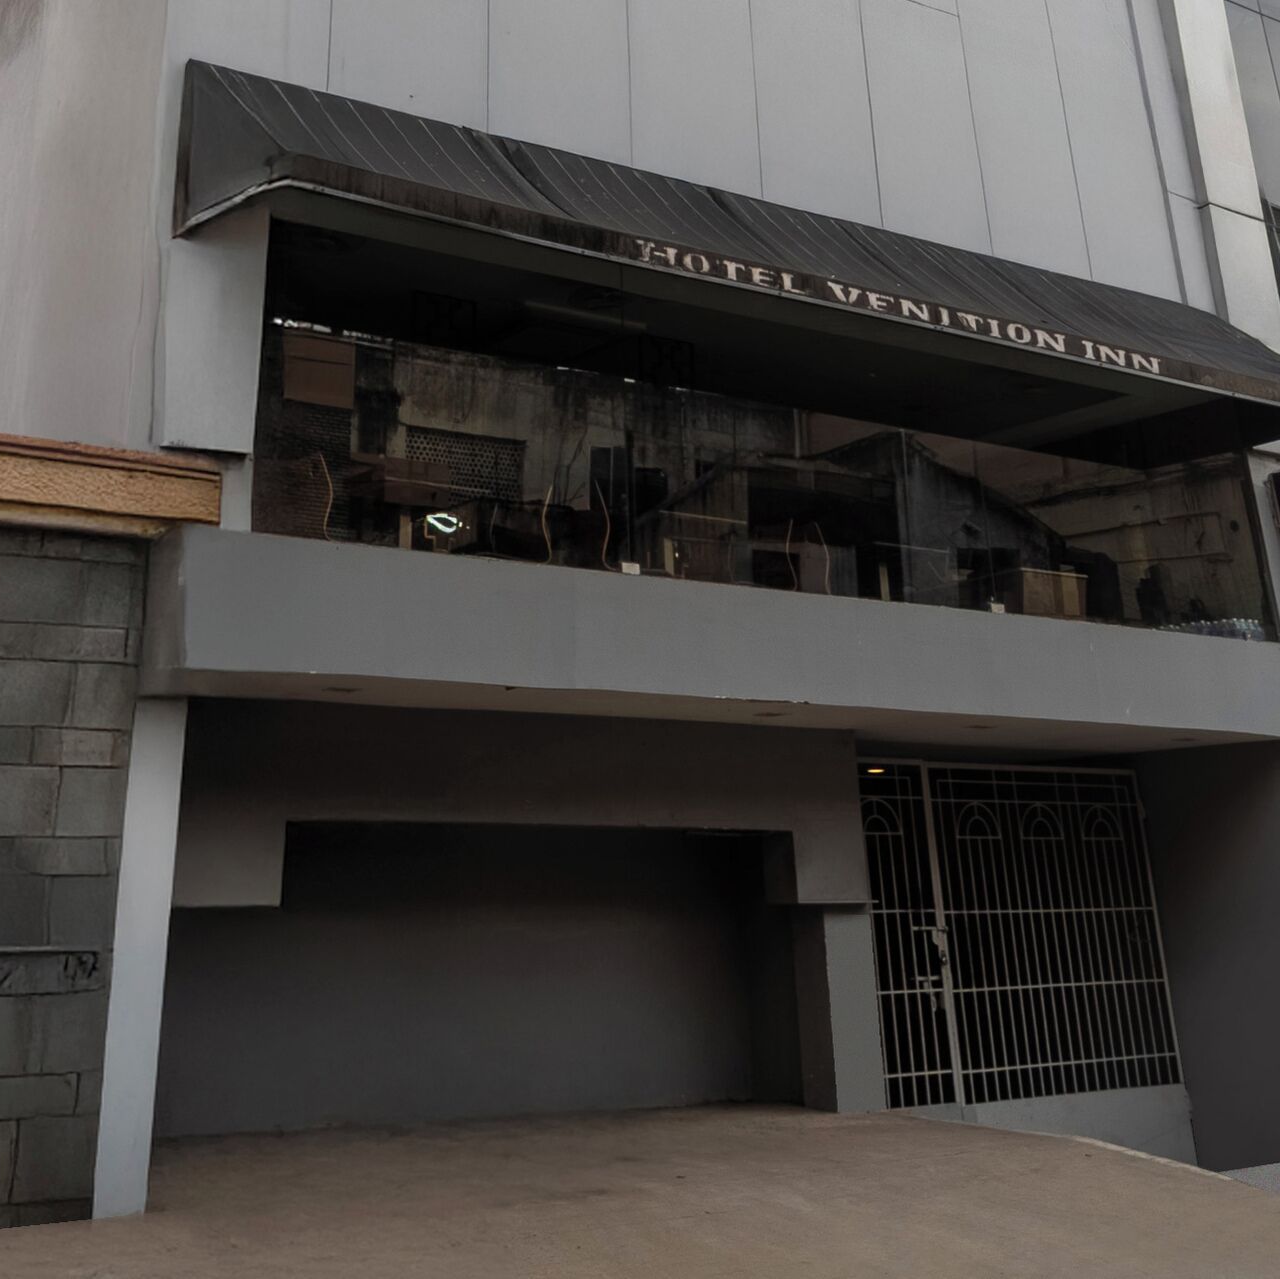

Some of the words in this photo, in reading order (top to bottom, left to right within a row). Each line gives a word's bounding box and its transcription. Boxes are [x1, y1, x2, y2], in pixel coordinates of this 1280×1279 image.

[635, 239, 805, 295] HOTEL
[827, 281, 1067, 353] VENITION
[1081, 340, 1161, 374] INN
